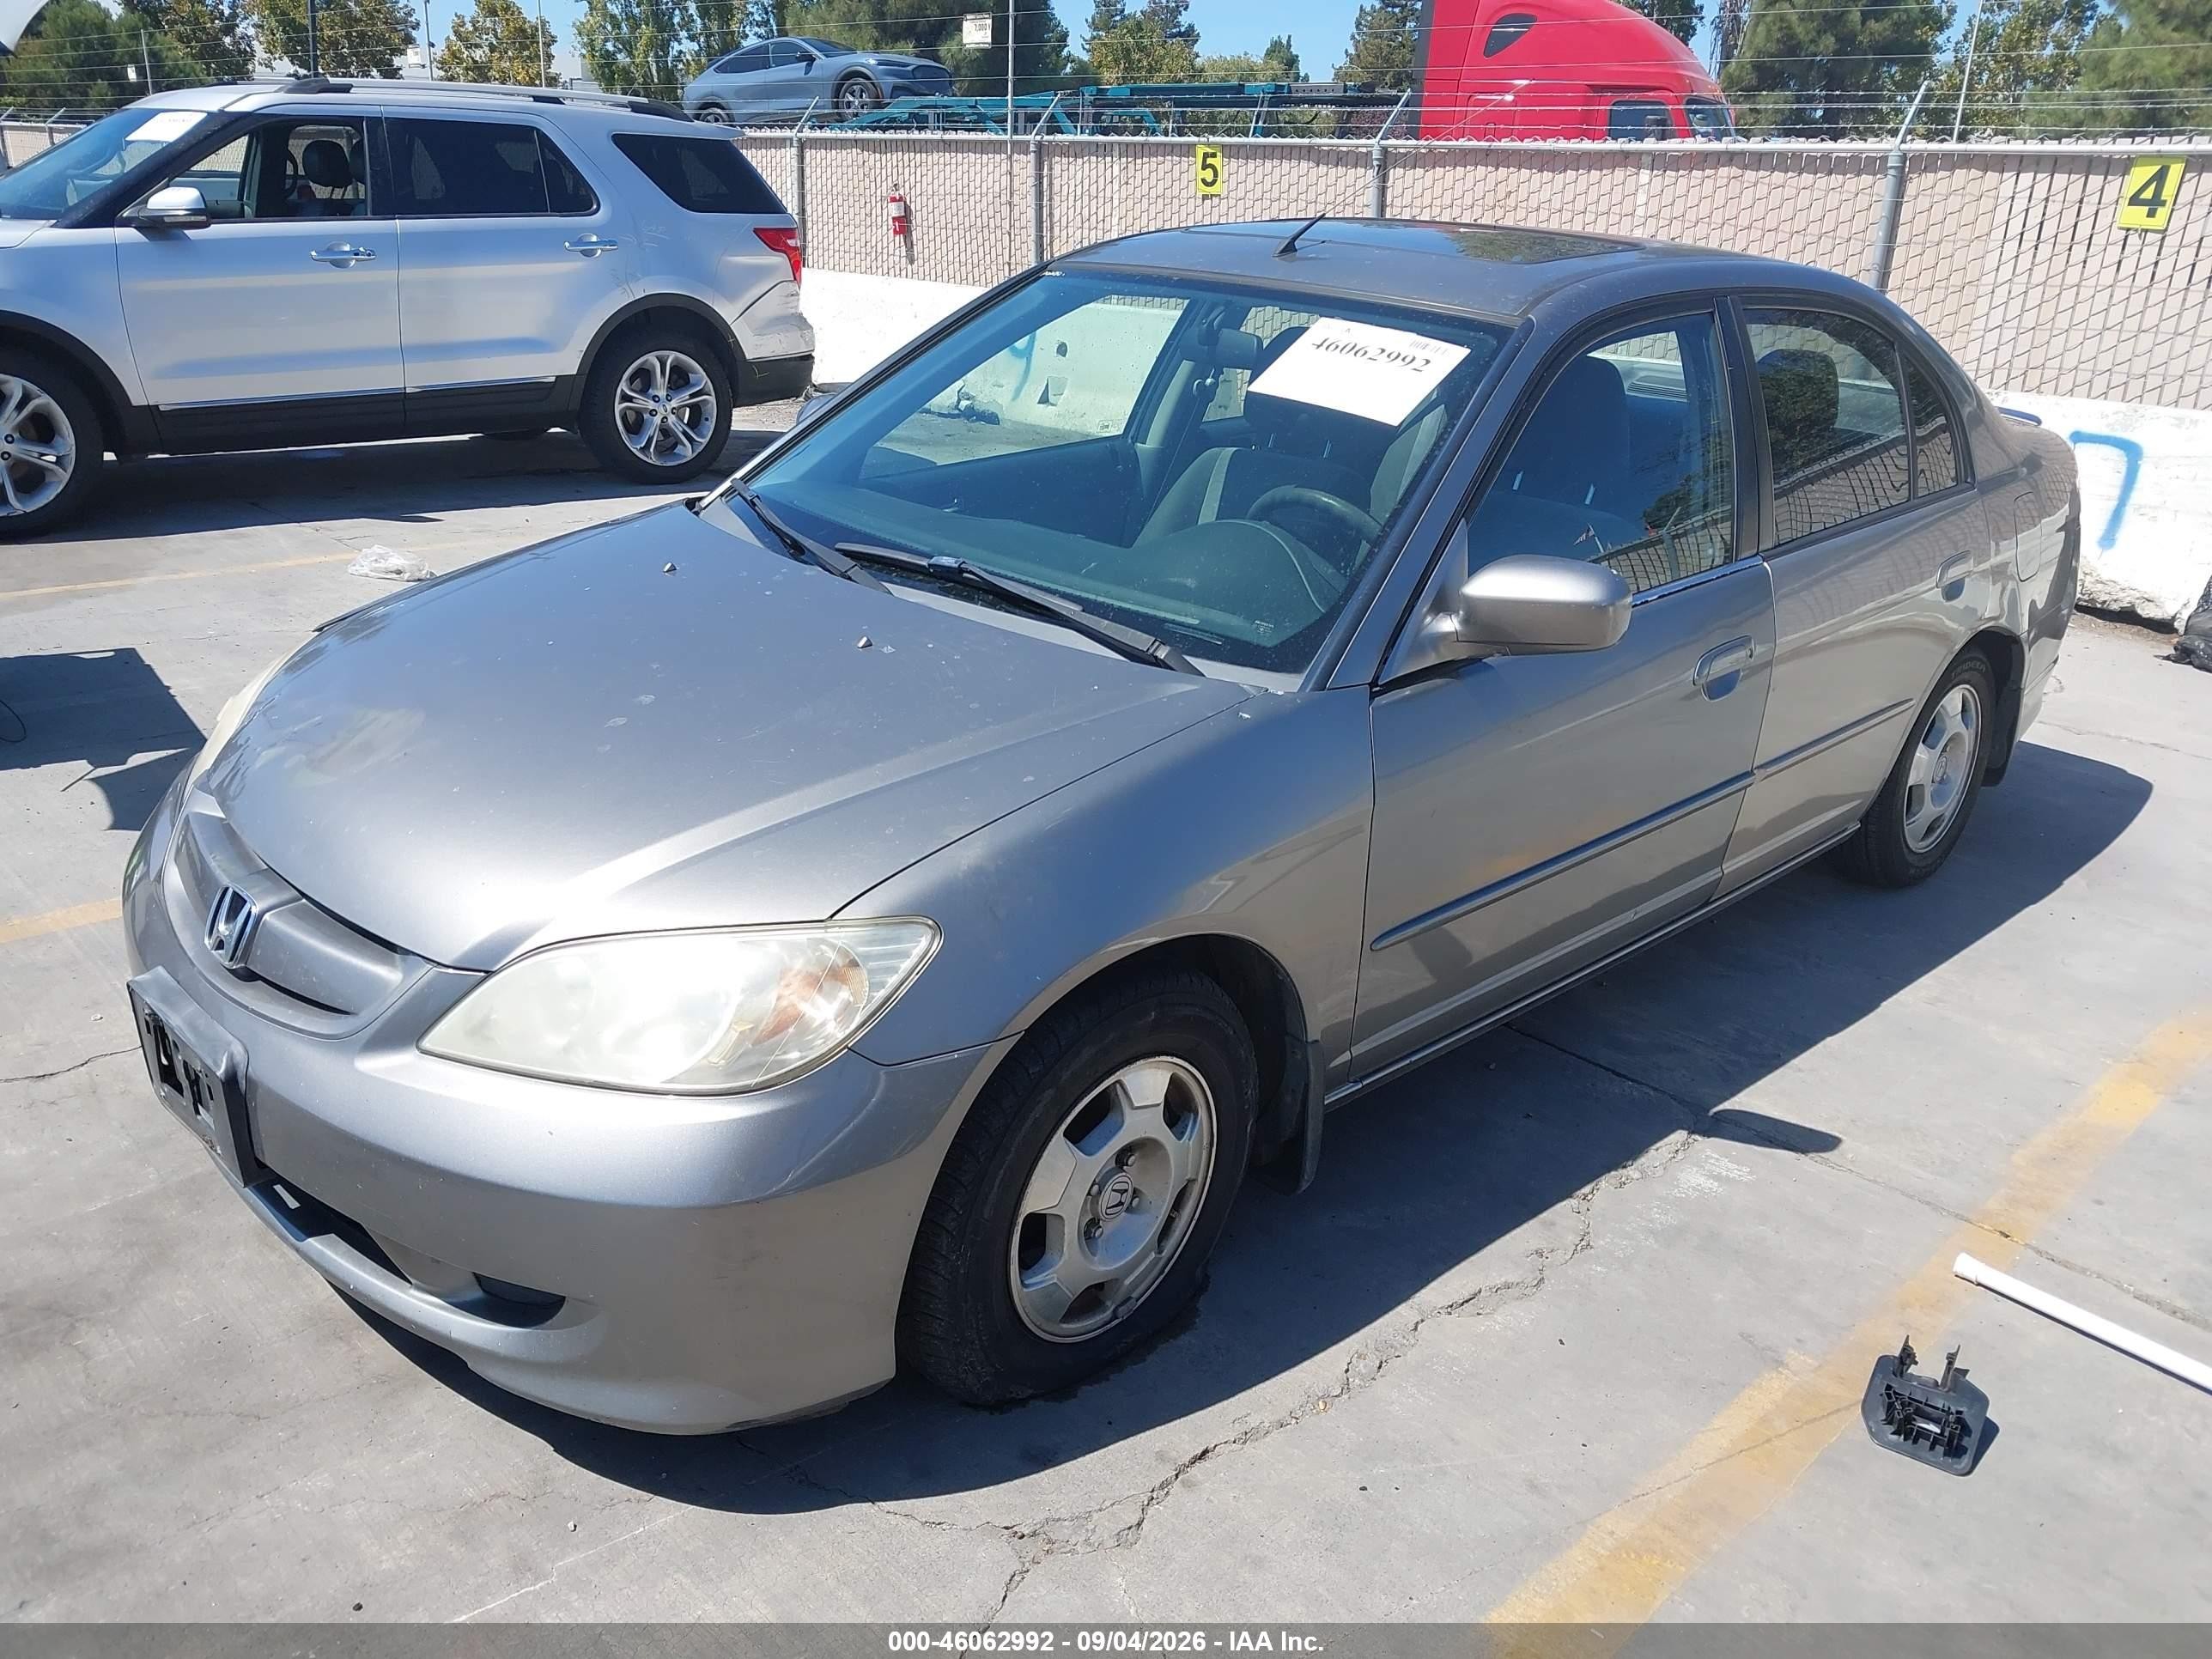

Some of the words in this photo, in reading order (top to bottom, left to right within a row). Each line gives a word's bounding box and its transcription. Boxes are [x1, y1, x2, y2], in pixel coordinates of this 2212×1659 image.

[1200, 151, 1218, 188] 5
[2127, 165, 2172, 218] 4
[1311, 336, 1432, 373] 46062992
